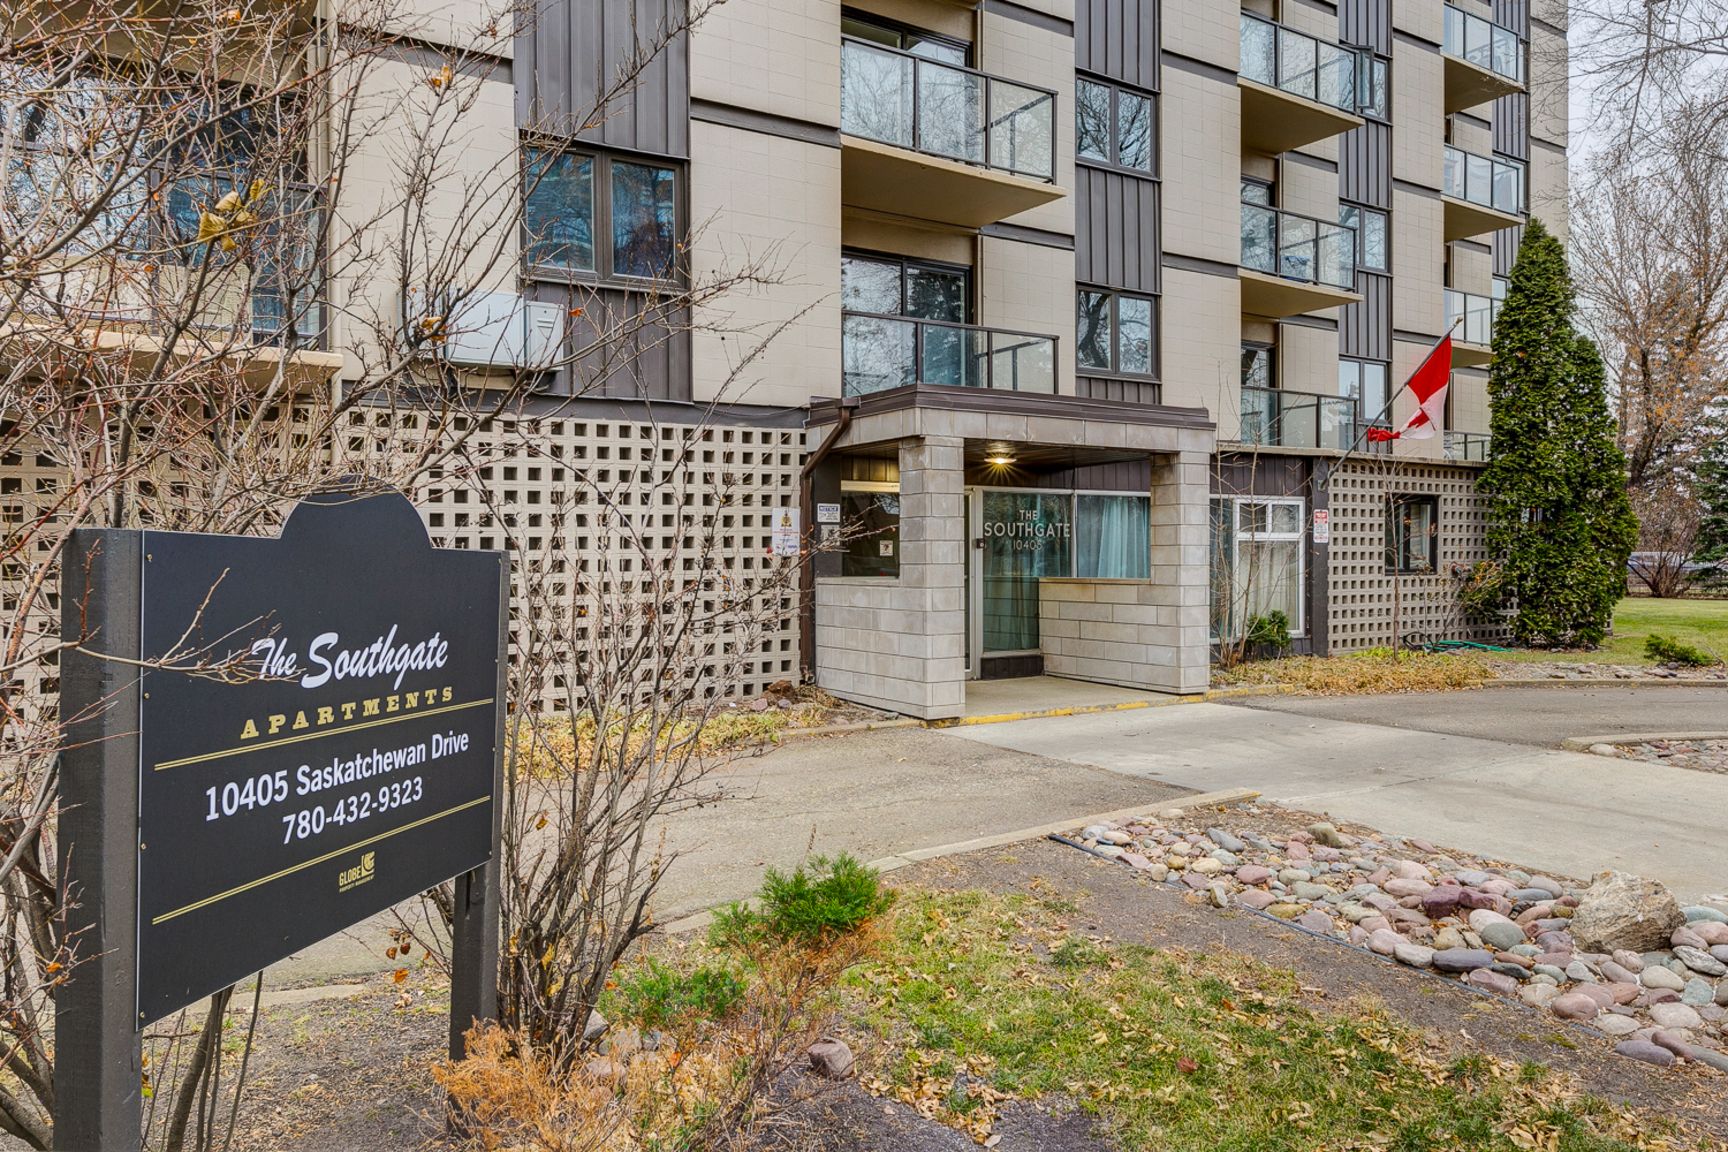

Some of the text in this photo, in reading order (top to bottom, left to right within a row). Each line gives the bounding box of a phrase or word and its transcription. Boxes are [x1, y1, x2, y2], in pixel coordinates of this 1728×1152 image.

[984, 522, 1071, 537] SOUTHGATE
[1019, 509, 1038, 521] THE
[1013, 539, 1043, 551] 10405
[252, 623, 449, 691] The Southgate
[240, 687, 453, 740] APARTMENTS
[205, 730, 470, 821] 10405 Saskatchewan Drive
[282, 776, 424, 845] 780-432-9323
[339, 865, 362, 887] GLOBE
